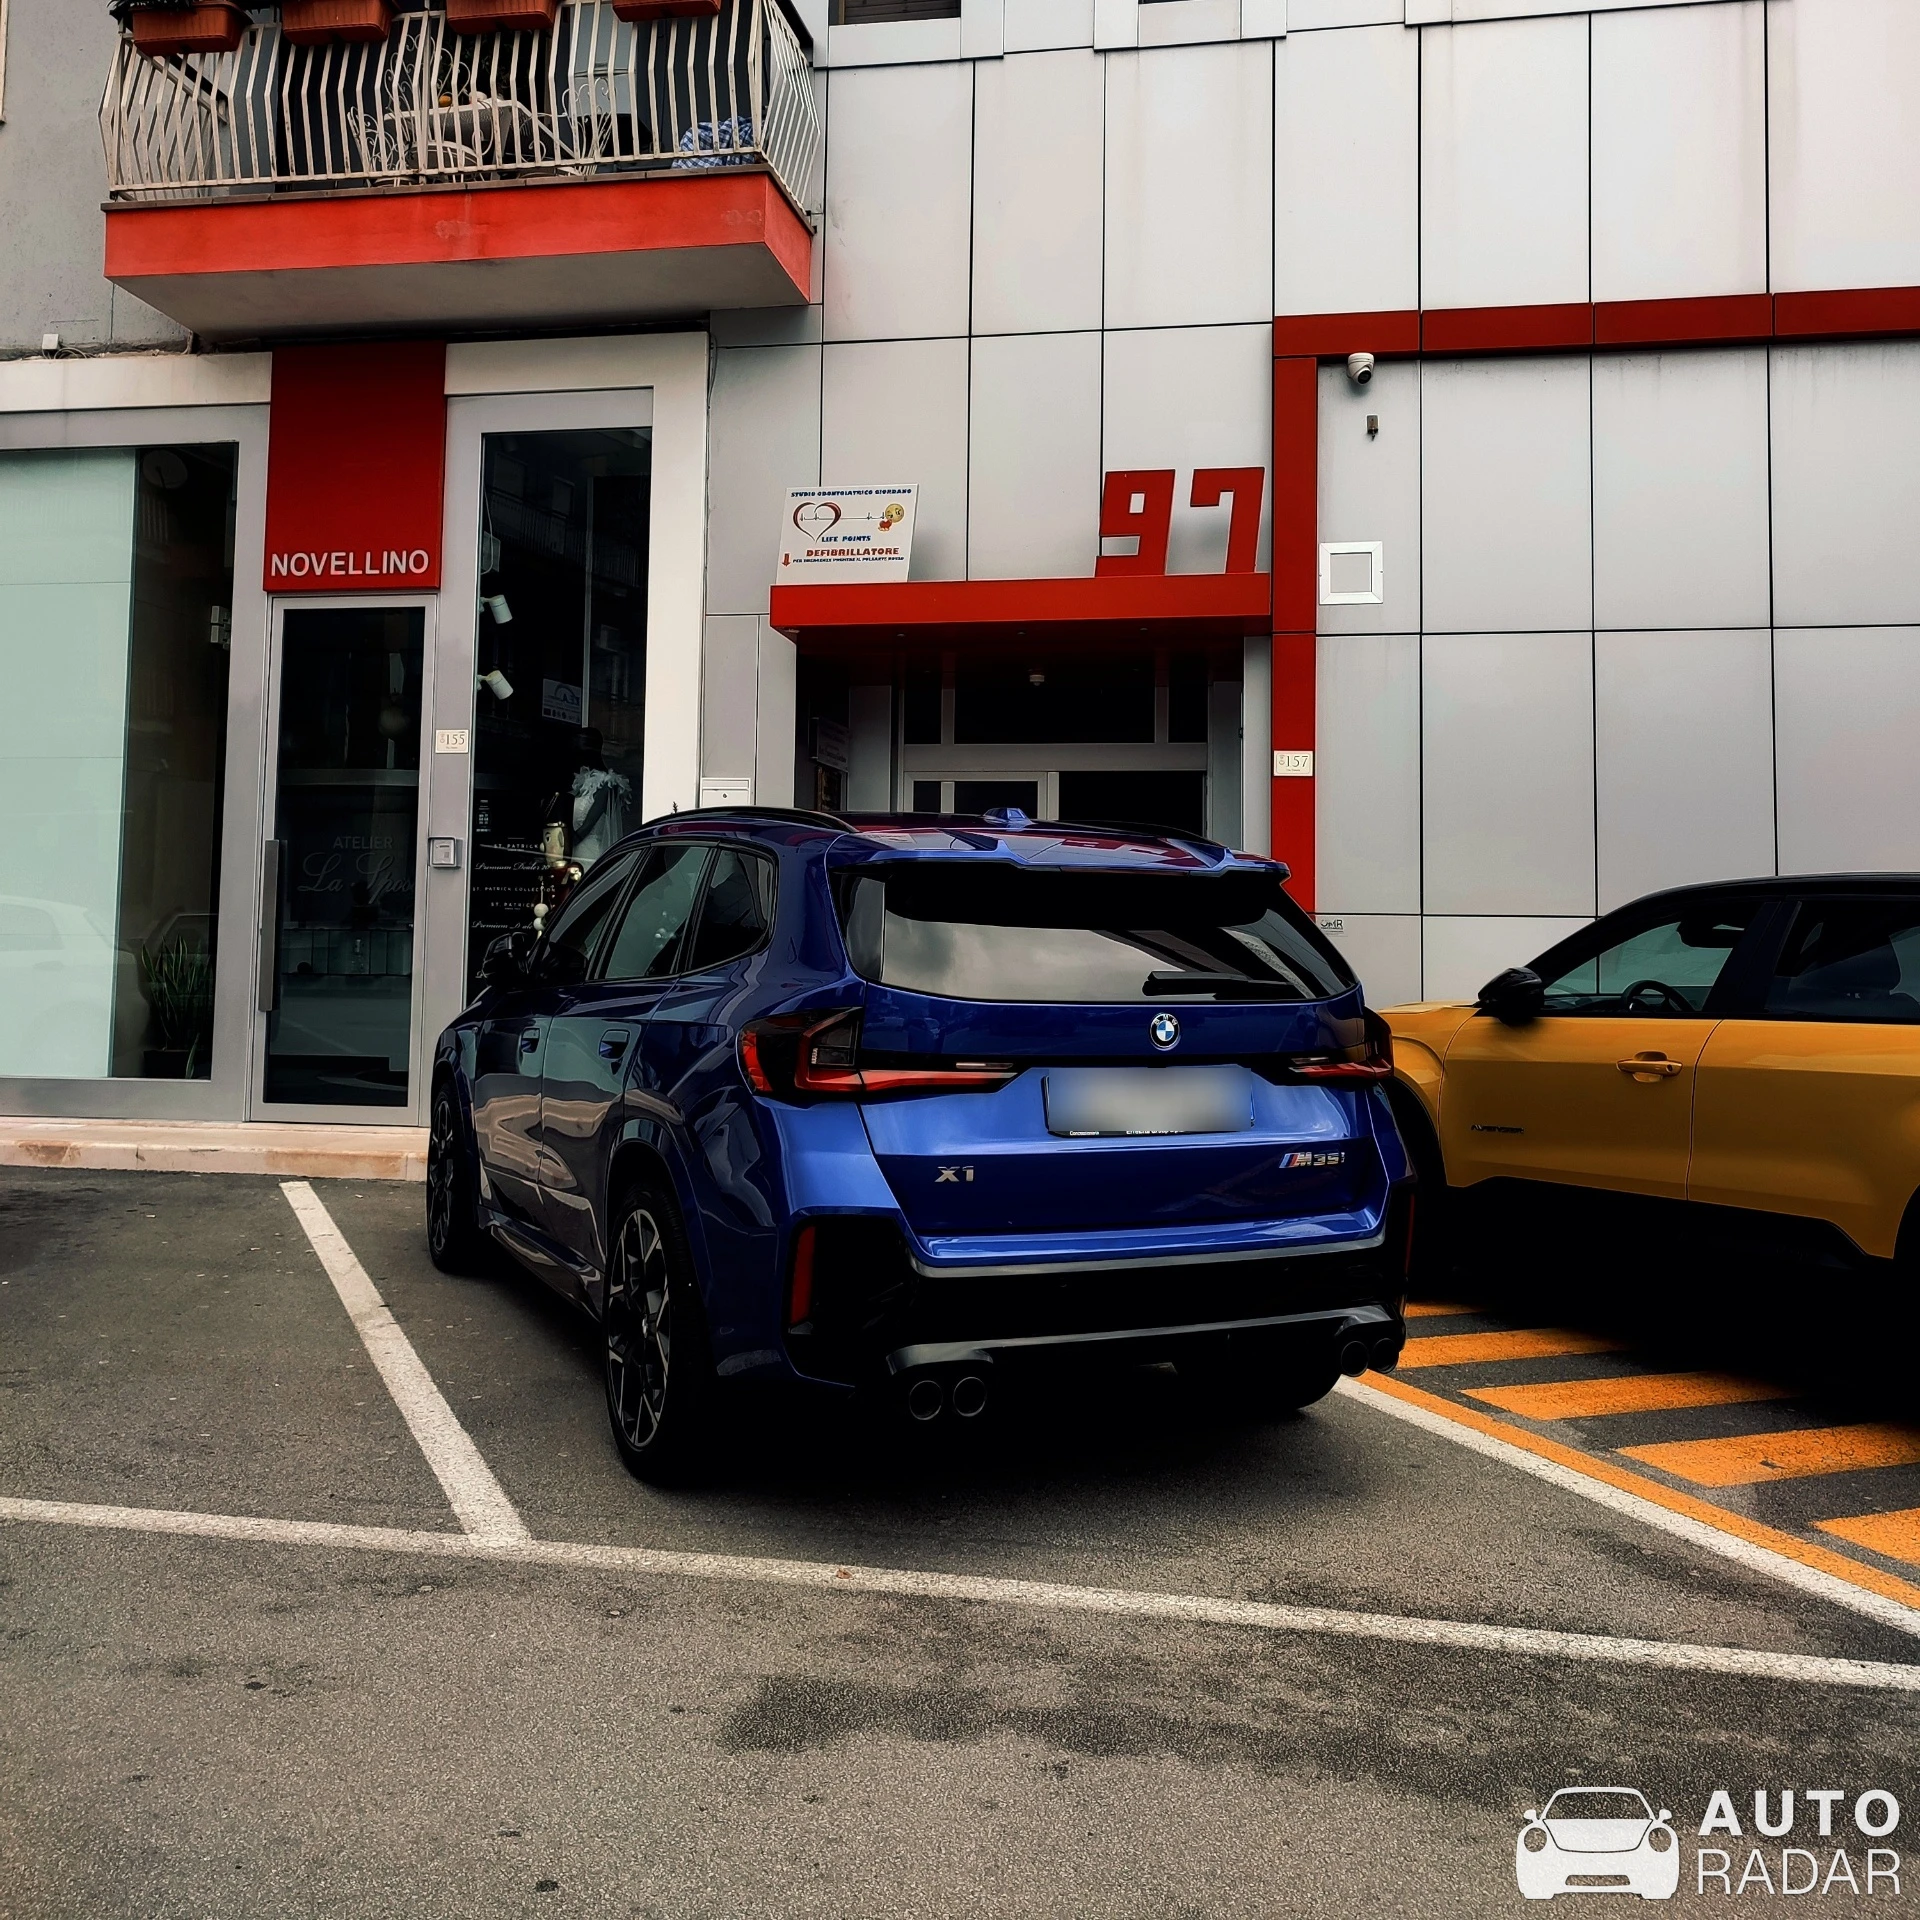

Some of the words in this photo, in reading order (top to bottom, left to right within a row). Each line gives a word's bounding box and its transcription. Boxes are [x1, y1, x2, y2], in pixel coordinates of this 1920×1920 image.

[817, 489, 873, 497] ODONTOIATRICO
[1095, 467, 1265, 577] 97
[806, 547, 900, 557] DEFIBRILLATORE
[271, 550, 429, 577] NOVELLINO
[446, 733, 465, 746] 155
[1286, 755, 1309, 768] 157
[333, 836, 393, 850] ATELIER
[297, 851, 344, 892] La
[1293, 1151, 1346, 1168] M35i
[934, 1165, 974, 1183] X1
